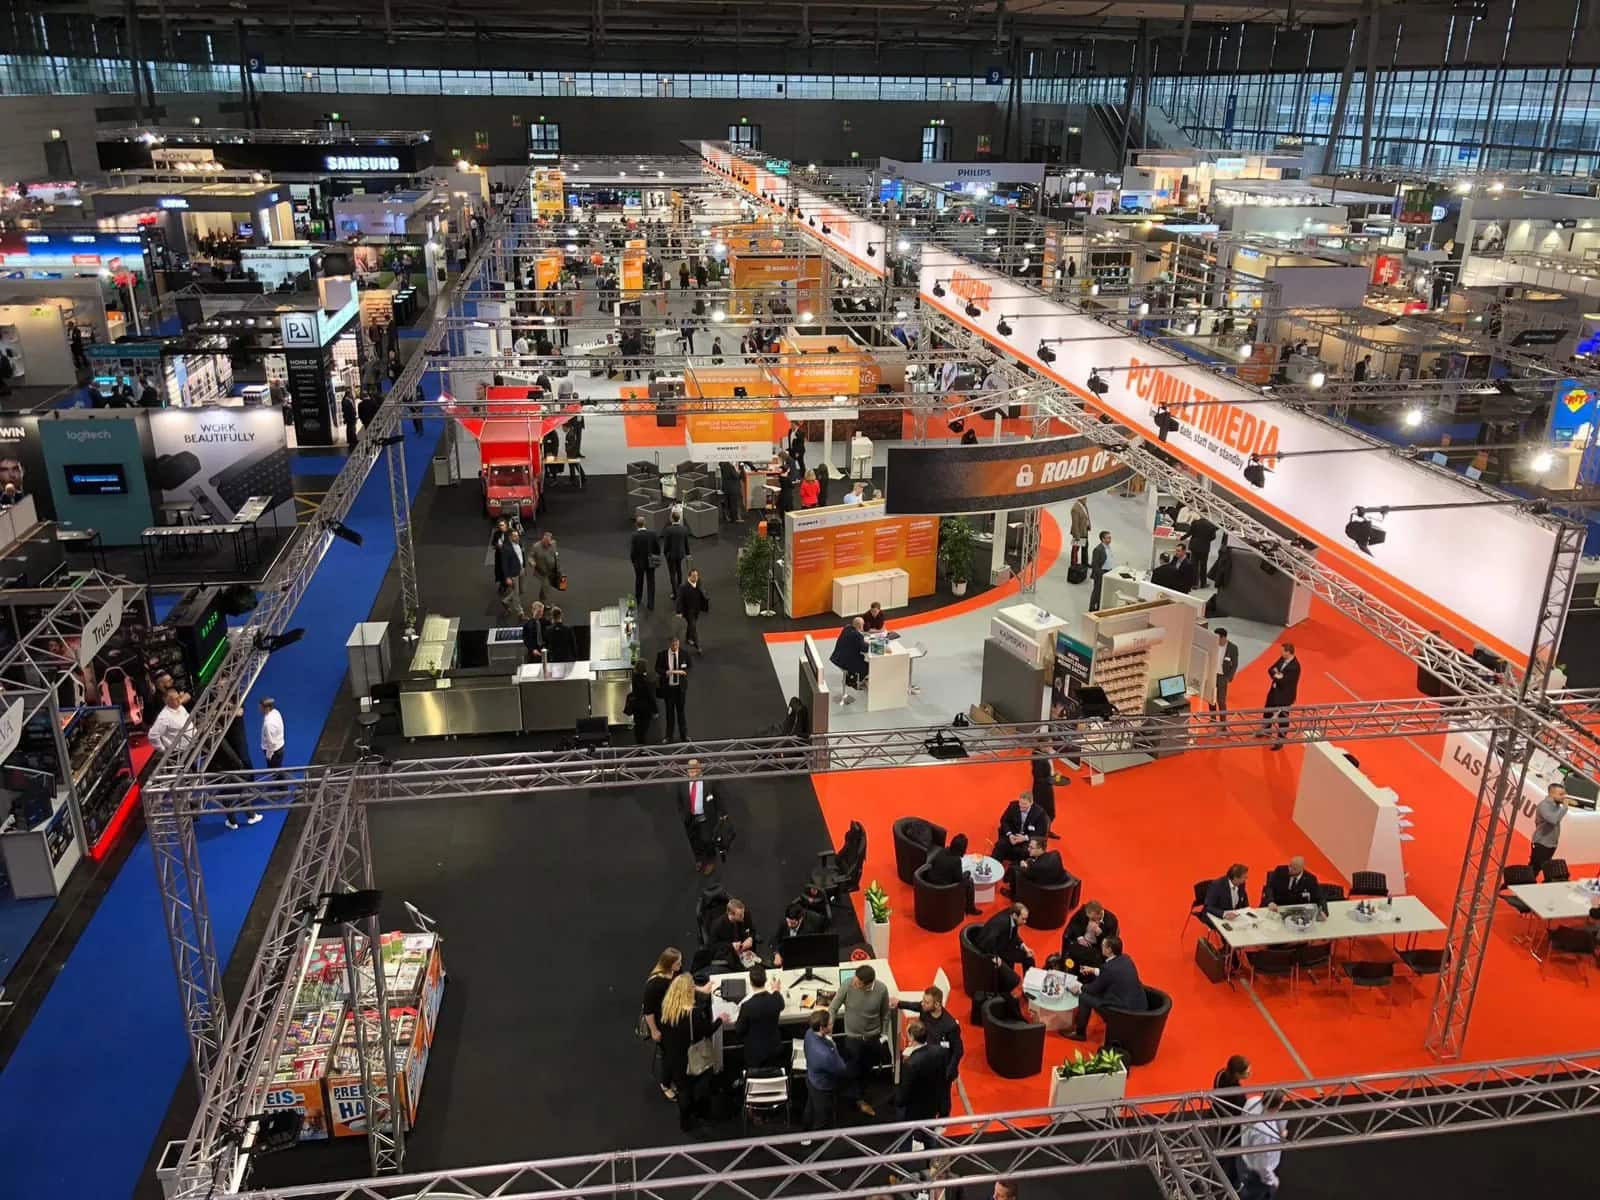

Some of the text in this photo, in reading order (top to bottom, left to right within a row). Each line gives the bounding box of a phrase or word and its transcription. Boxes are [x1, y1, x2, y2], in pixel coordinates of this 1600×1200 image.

[250, 58, 258, 70] 9
[991, 71, 1000, 82] 9
[327, 156, 400, 171] SAMSUNG
[957, 168, 992, 177] PHILIPS
[1125, 357, 1280, 470] PC/MULTIMEDIA
[66, 429, 112, 442] logitech
[200, 424, 237, 433] WORK
[184, 432, 255, 444] BEAUTIFULLY
[1040, 455, 1090, 485] ROAD
[1091, 450, 1110, 474] OF
[92, 613, 114, 645] Trust
[266, 1089, 305, 1106] EIS-
[333, 1085, 364, 1100] PREI
